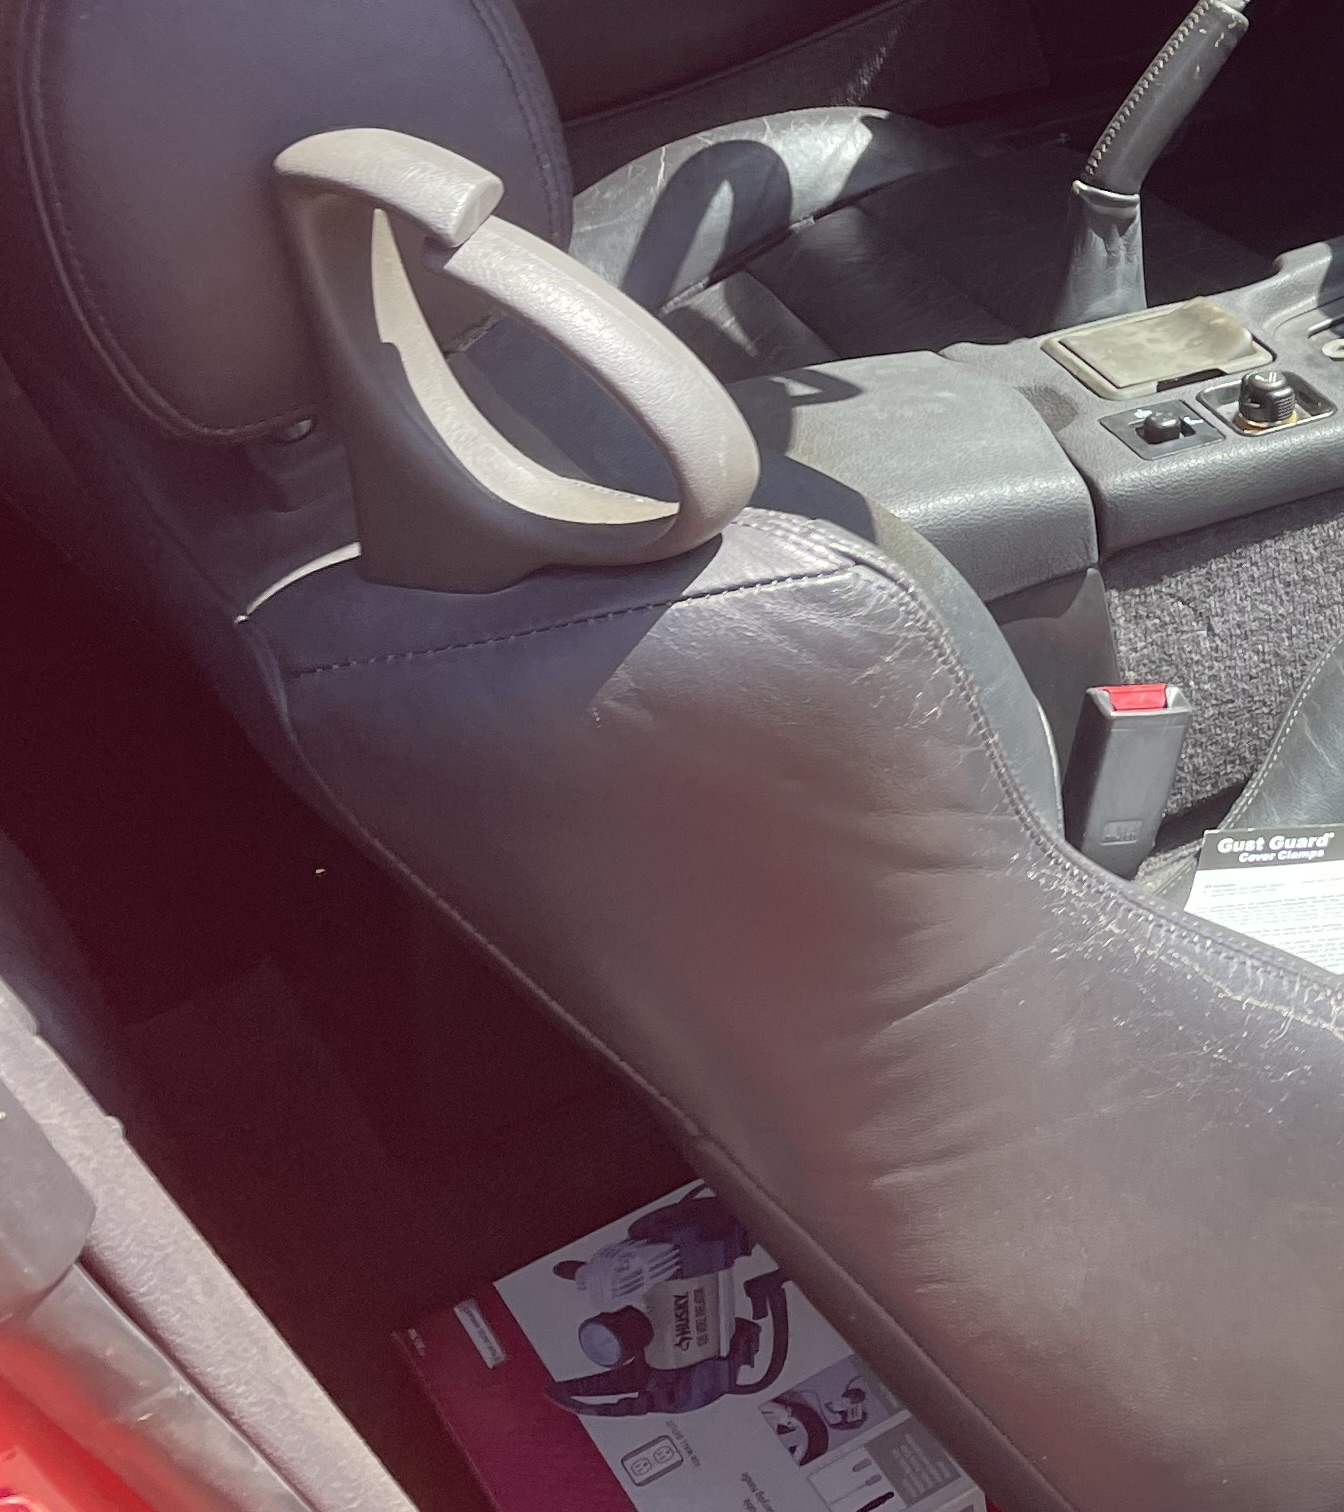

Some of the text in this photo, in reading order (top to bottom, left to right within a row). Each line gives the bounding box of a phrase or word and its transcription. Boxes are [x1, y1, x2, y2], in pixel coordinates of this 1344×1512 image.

[1217, 834, 1332, 854] Gust Guard
[1238, 849, 1326, 863] Cover Clamps
[673, 1290, 692, 1338] HUSKY
